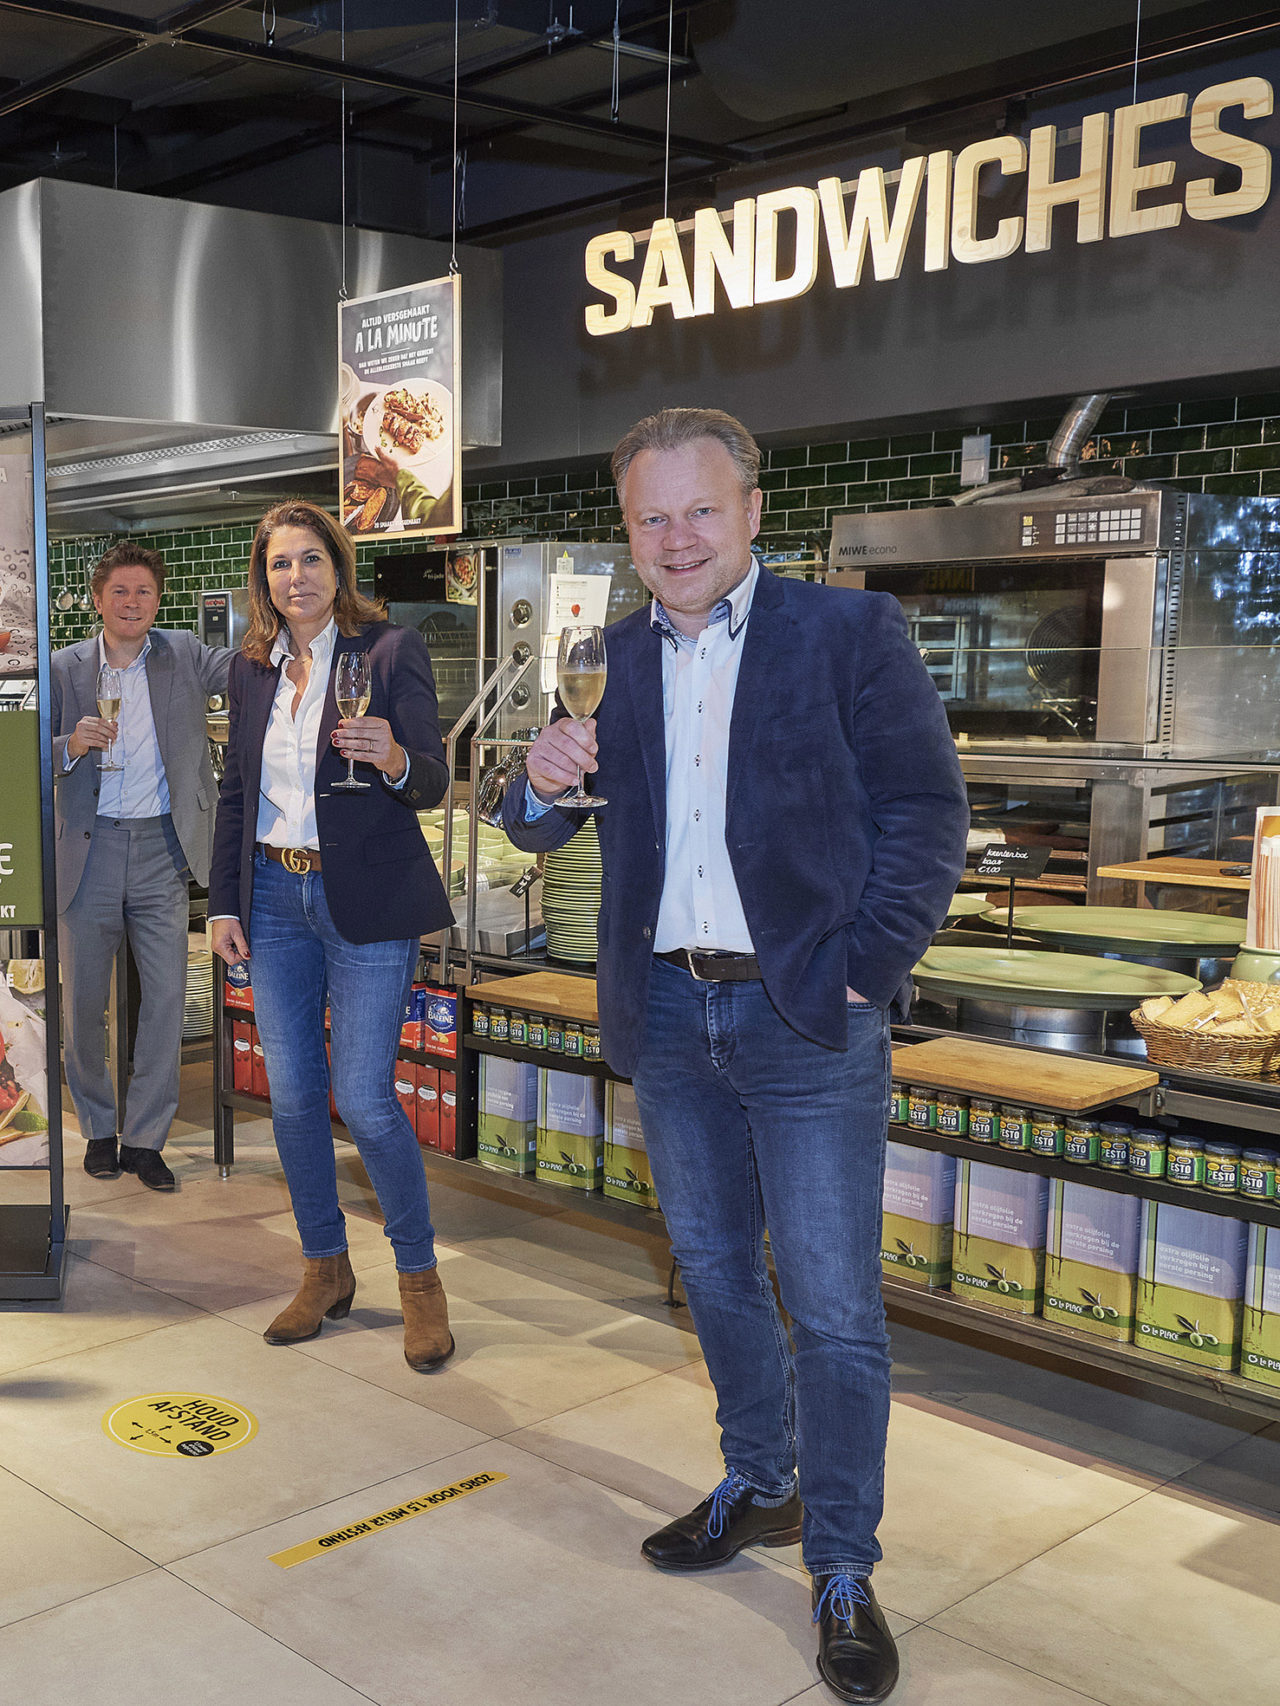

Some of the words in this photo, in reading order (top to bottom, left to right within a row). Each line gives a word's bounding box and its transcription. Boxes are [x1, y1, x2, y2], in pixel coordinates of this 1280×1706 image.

[585, 76, 1273, 337] SANDWICHES
[362, 316, 382, 328] ALTIJD
[383, 304, 430, 324] VERSGEMAAKT
[355, 332, 364, 354] A
[368, 328, 382, 352] LA
[386, 316, 438, 348] MINUTE
[838, 546, 868, 556] MIWE
[1102, 1148, 1126, 1160] PESTO
[1129, 1154, 1146, 1167] ESTO
[1208, 1170, 1236, 1182] PESTO
[1242, 1175, 1263, 1188] ESTO
[992, 1220, 1018, 1232] persing
[1101, 1238, 1110, 1248] bij
[1088, 1244, 1114, 1256] persing
[1160, 1246, 1180, 1256] extra
[1181, 1250, 1210, 1262] olijfolie
[1184, 1266, 1214, 1280] persing
[1200, 1262, 1209, 1272] bij
[1268, 1359, 1280, 1370] PLA
[182, 1400, 240, 1427] HOUD
[147, 1402, 231, 1441] AFSTAND
[458, 1474, 495, 1490] ZORG
[423, 1487, 464, 1504] VOOR
[406, 1500, 428, 1513] 1,5
[370, 1508, 410, 1527] METER
[318, 1522, 372, 1548] AFSTAND
